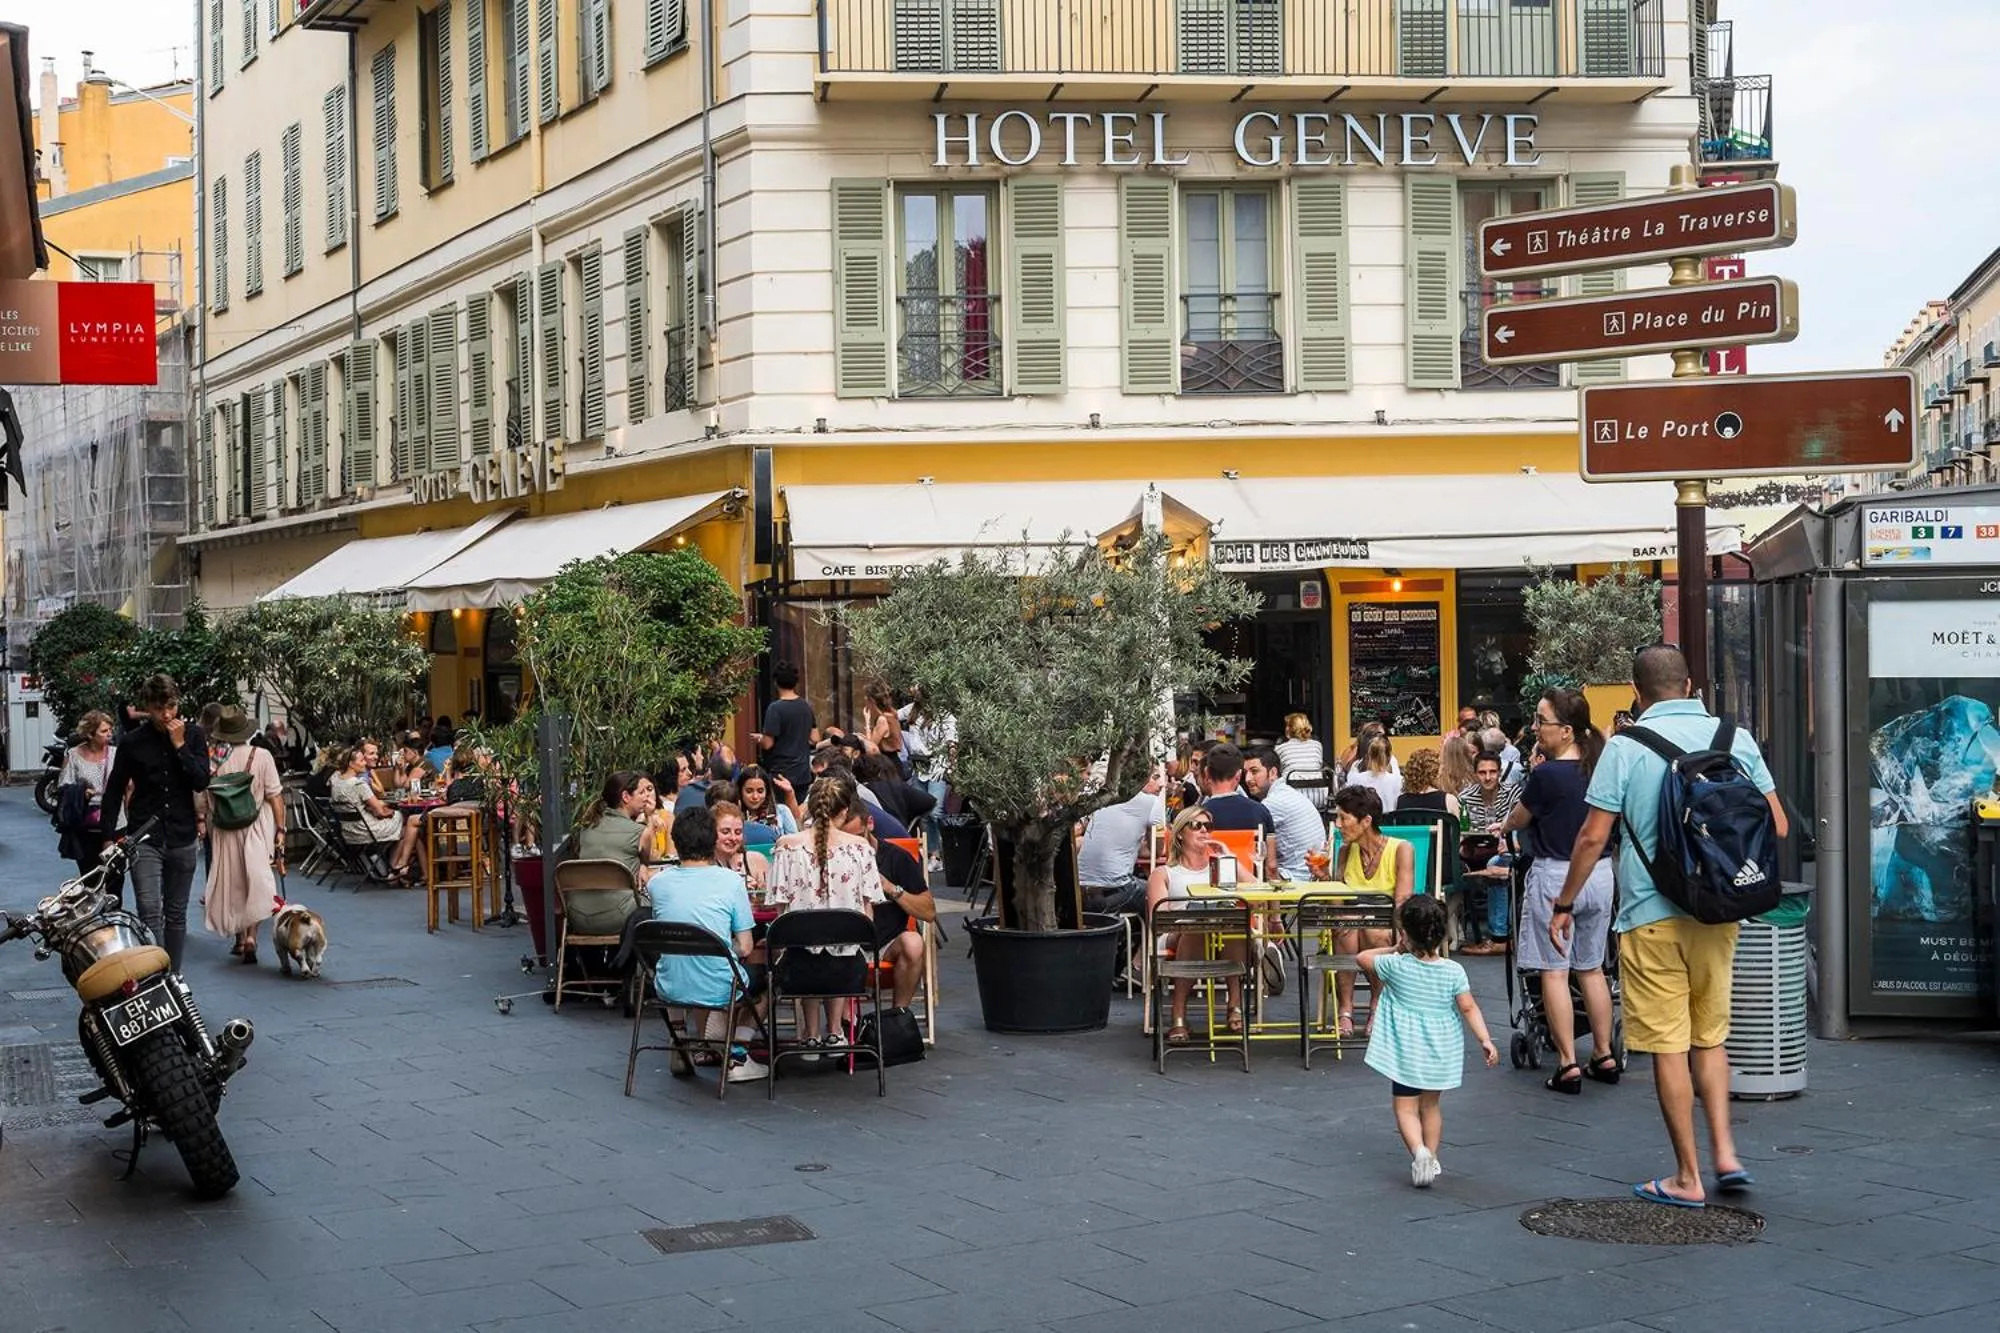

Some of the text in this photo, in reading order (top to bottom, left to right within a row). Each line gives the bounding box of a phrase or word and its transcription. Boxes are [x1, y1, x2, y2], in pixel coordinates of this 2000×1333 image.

[930, 110, 1542, 166] HOTEL GENEVE
[1555, 207, 1770, 249] Théâtre La Traverse
[1632, 300, 1771, 331] Place du Pin
[70, 322, 145, 334] LYMPIA
[8, 341, 33, 352] LIKE
[1626, 420, 1710, 440] Le Port
[411, 438, 565, 505] HOTEL GENEVE
[1869, 510, 1949, 524] GARIBALDI
[1917, 526, 1996, 538] 3 7 38
[1214, 540, 1370, 563] CAFE DES CHINEURS
[1632, 546, 1657, 557] BAR
[822, 565, 856, 577] CAFE
[1932, 629, 1997, 645] MOËT &
[1734, 871, 1765, 886] adidas
[1920, 937, 1954, 946] MUST
[1959, 938, 1976, 947] BE
[119, 1002, 175, 1039] 887-VM
